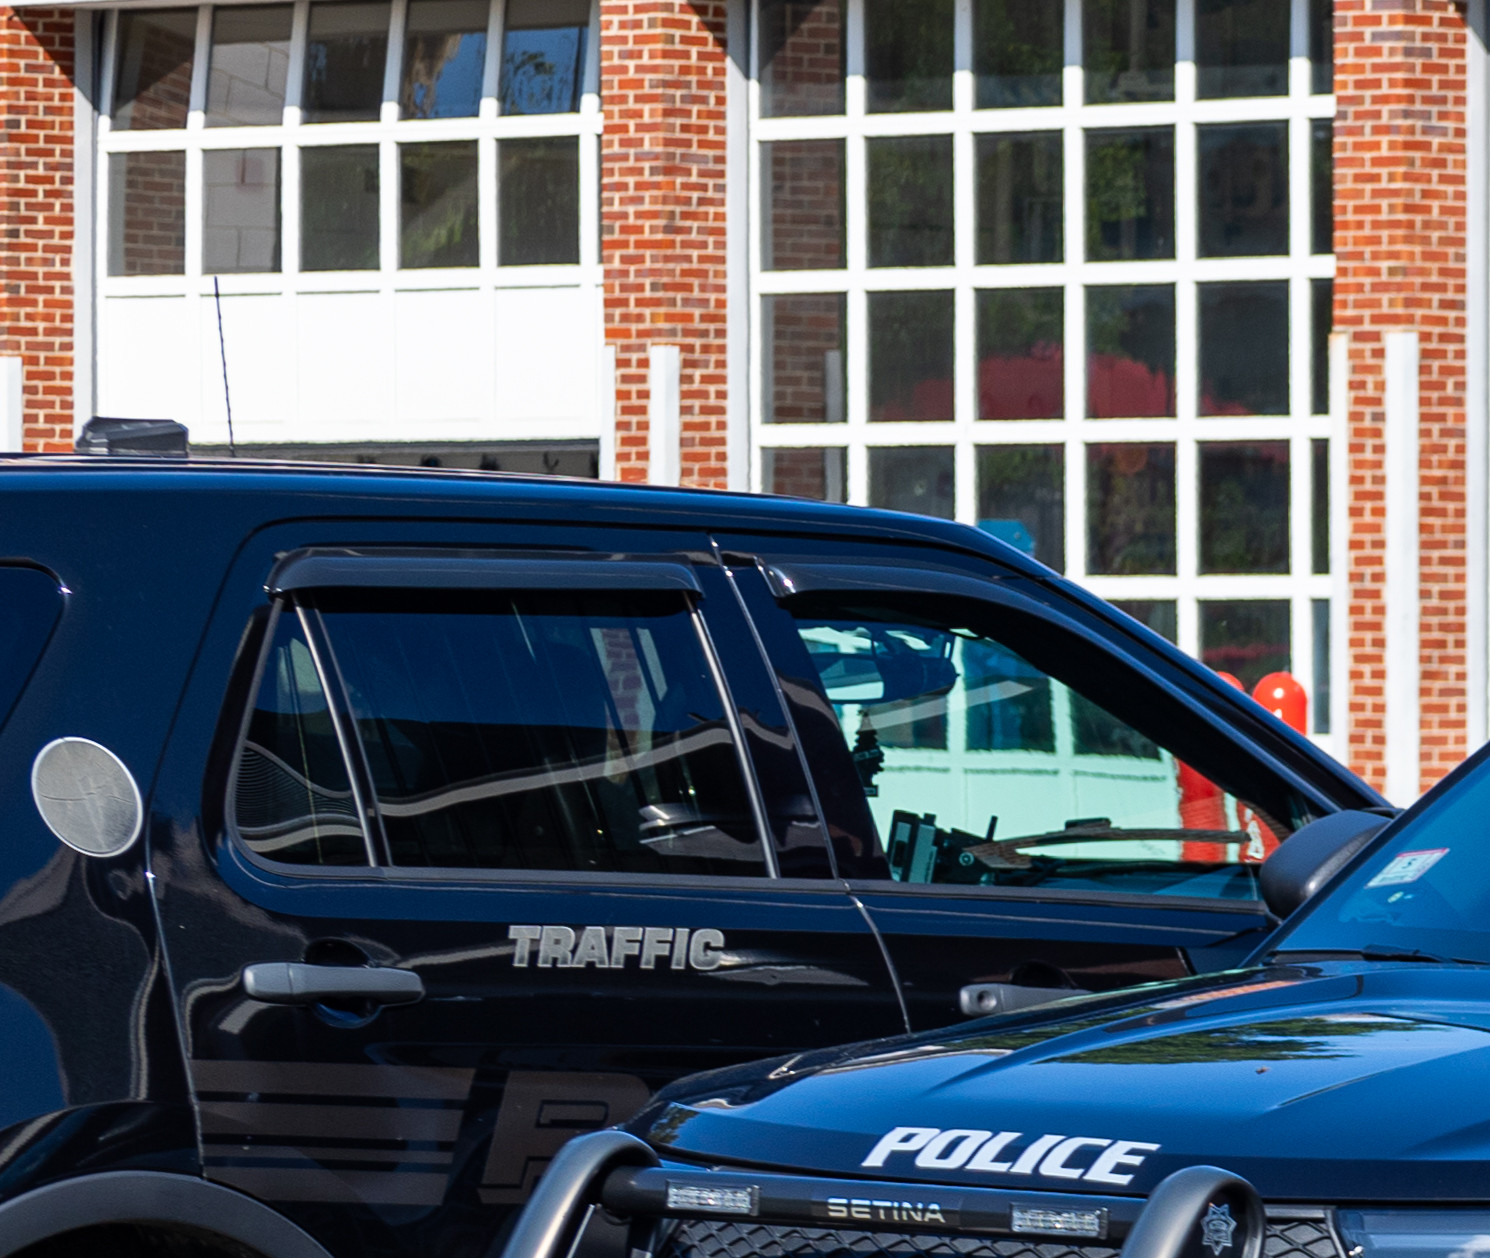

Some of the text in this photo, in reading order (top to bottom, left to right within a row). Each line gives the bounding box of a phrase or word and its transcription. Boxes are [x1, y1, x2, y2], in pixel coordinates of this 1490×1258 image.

[507, 924, 726, 971] TRAFFIC
[860, 1126, 1162, 1185] POLICE
[826, 1196, 946, 1225] SETINA
